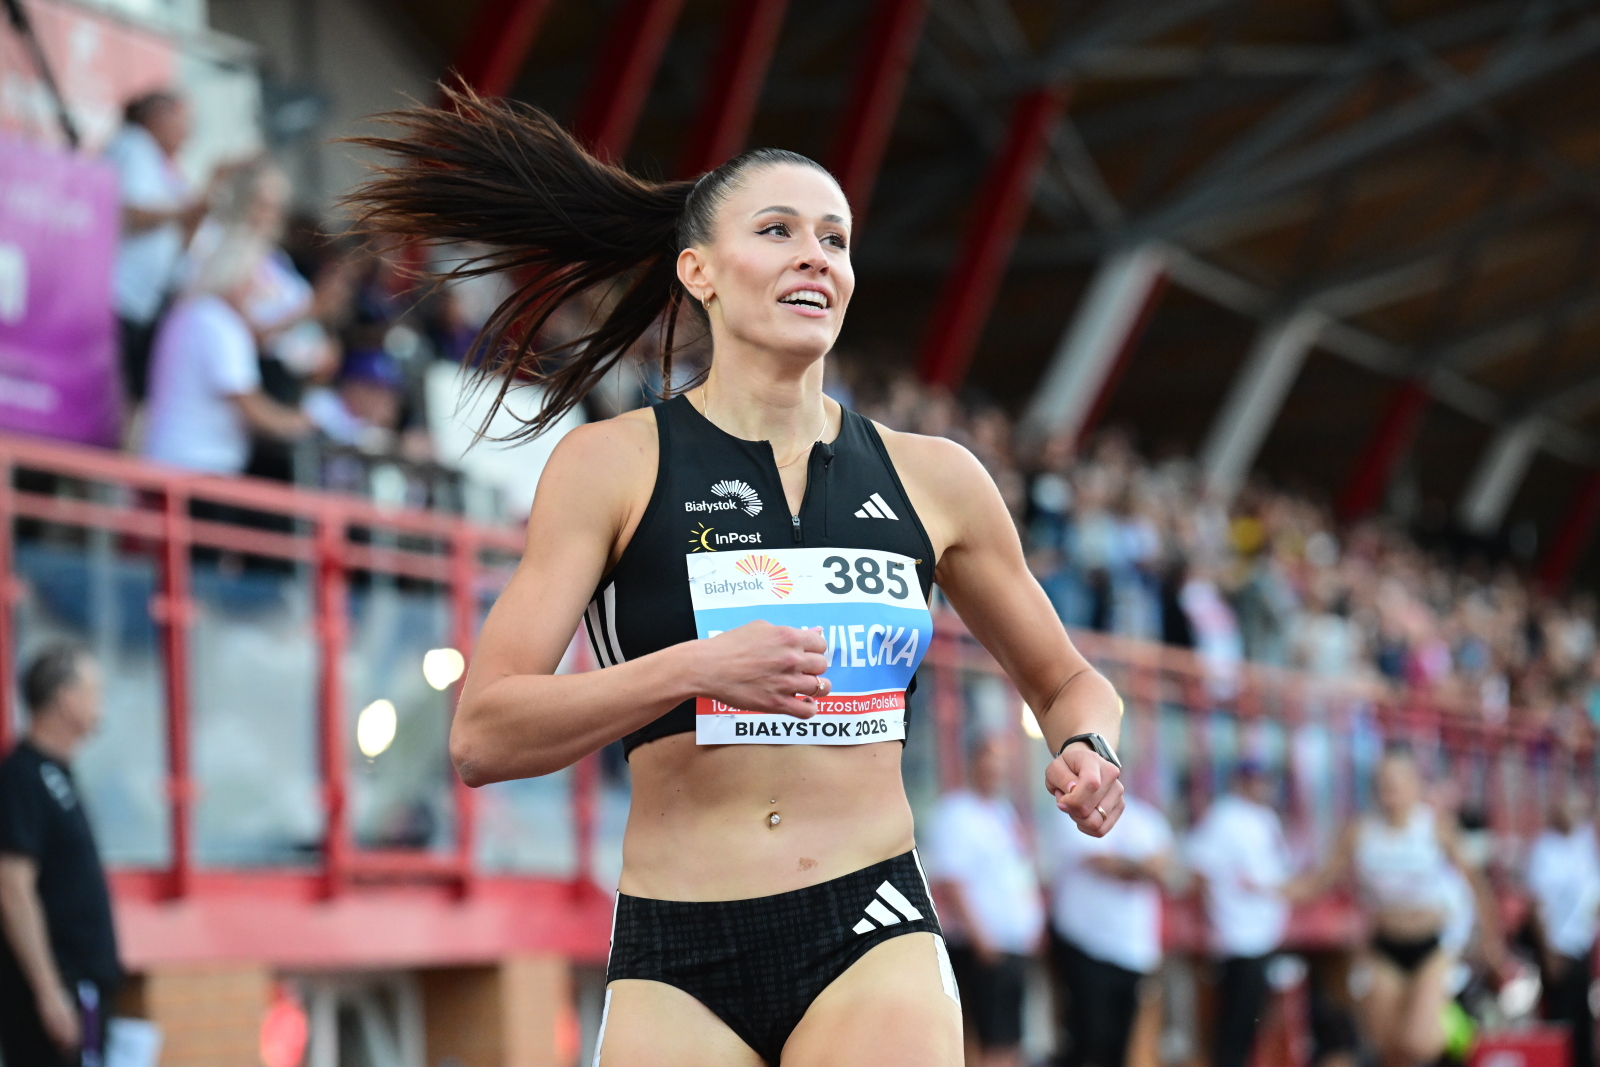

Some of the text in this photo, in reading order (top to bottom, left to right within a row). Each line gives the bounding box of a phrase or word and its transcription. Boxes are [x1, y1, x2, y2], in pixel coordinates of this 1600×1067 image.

[684, 499, 738, 514] Białystok
[715, 531, 762, 545] InPost
[704, 577, 764, 596] Białystok
[822, 555, 909, 600] 385
[708, 624, 919, 667] WIECKA
[816, 699, 871, 712] trzostwa
[871, 694, 899, 710] Polski
[735, 718, 888, 737] BIAŁYSTOK 2026
